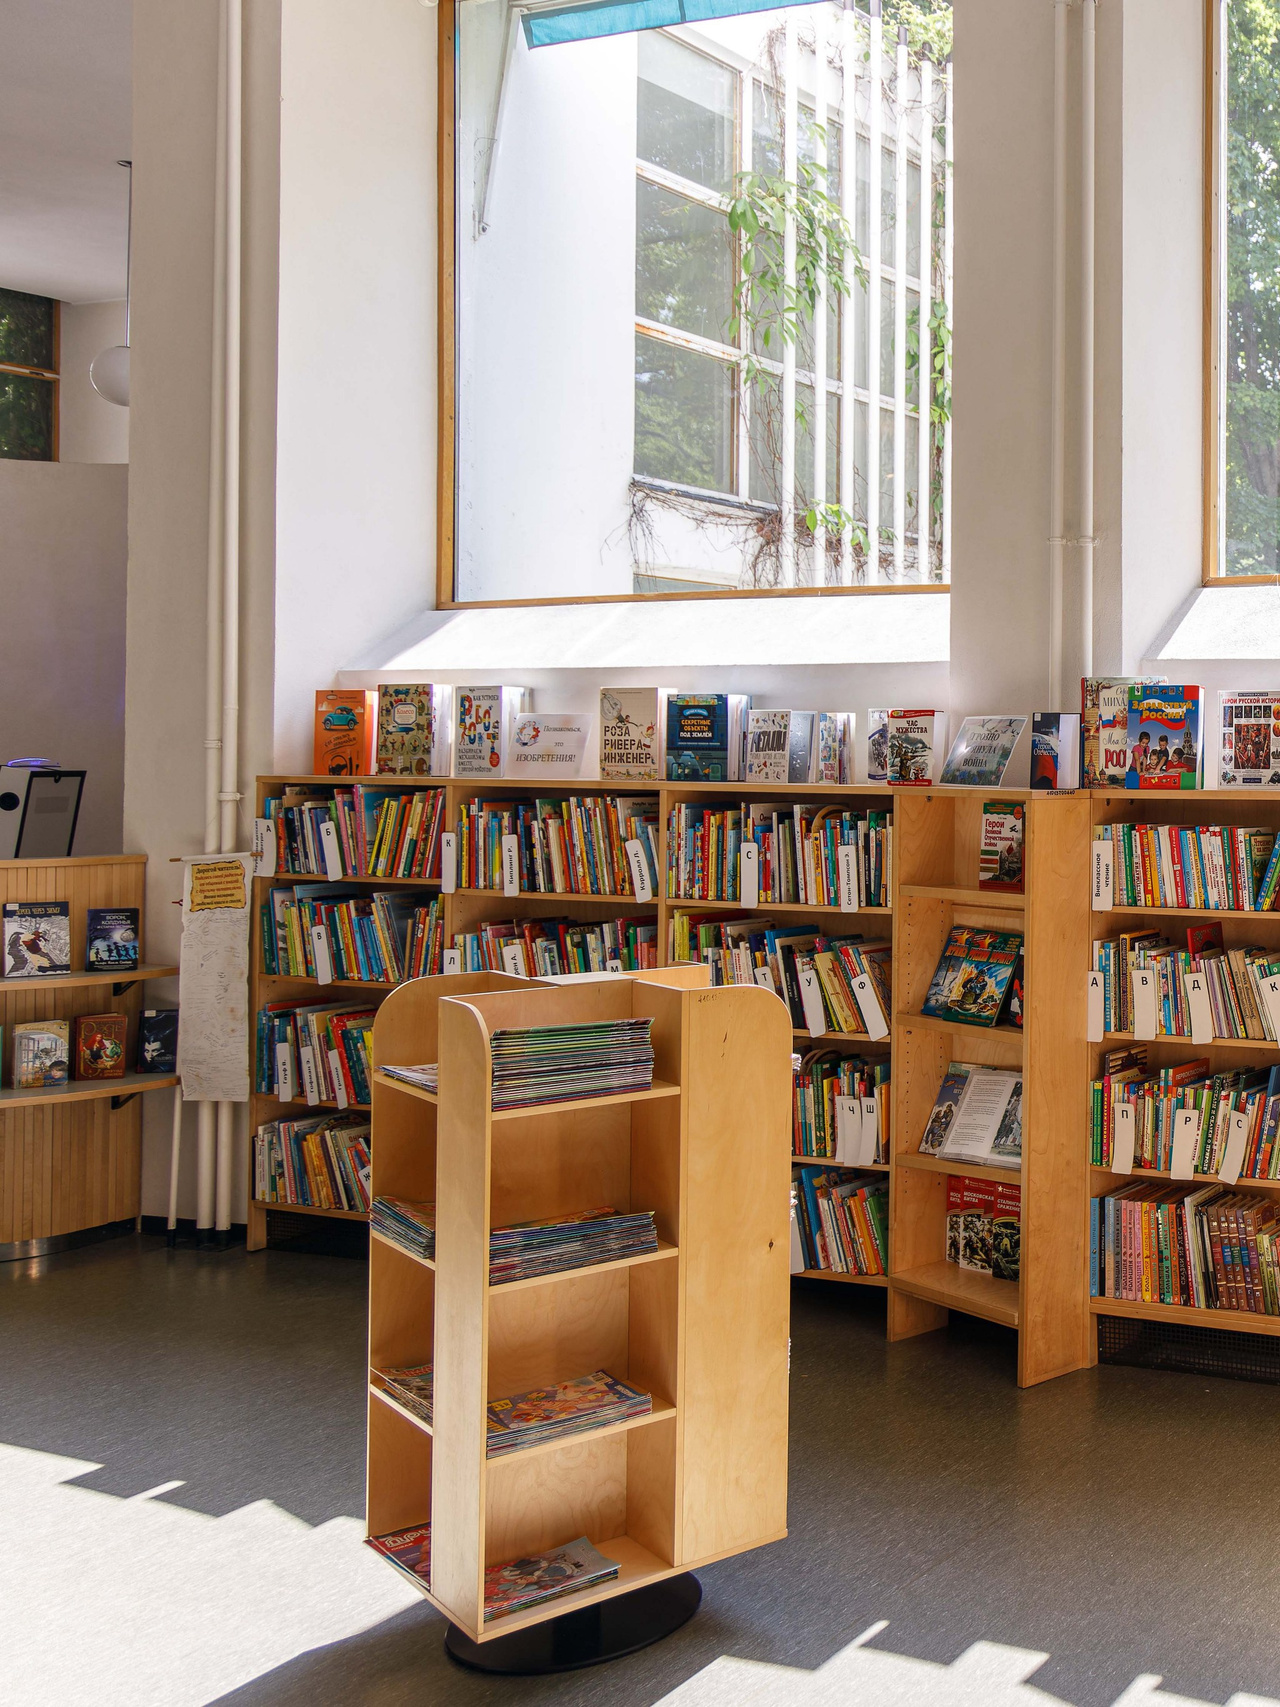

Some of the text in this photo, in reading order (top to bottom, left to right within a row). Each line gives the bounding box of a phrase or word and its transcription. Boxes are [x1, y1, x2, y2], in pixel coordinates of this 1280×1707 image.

[1132, 700, 1195, 711] ЗДРАВСТВУЙ,
[543, 725, 582, 734] Познакомься,
[603, 725, 631, 737] РОЗА
[896, 726, 928, 734] МУЖЕСТВА
[603, 739, 646, 751] РИВЕРА,
[516, 753, 576, 763] ИЗОБРЕТЕНИЯ!
[603, 752, 651, 764] ИНЖЕНЕР
[962, 757, 987, 768] ВОЙНА
[266, 824, 272, 832] А
[985, 819, 1005, 829] Герои
[326, 828, 330, 836] Б
[746, 850, 752, 860] С
[637, 861, 646, 891] Кэрролл
[317, 932, 322, 940] В
[448, 957, 455, 966] Л
[762, 972, 767, 982] Т
[806, 977, 812, 986] У
[1090, 976, 1098, 988] А
[1141, 976, 1148, 986] В
[858, 981, 866, 990] Ф
[1192, 980, 1202, 991] Д
[1270, 982, 1278, 992] К
[848, 1106, 855, 1114] Ч
[866, 1104, 874, 1114] Ш
[1122, 1110, 1128, 1119] П
[1184, 1116, 1192, 1126] Р
[1236, 1119, 1243, 1128] С
